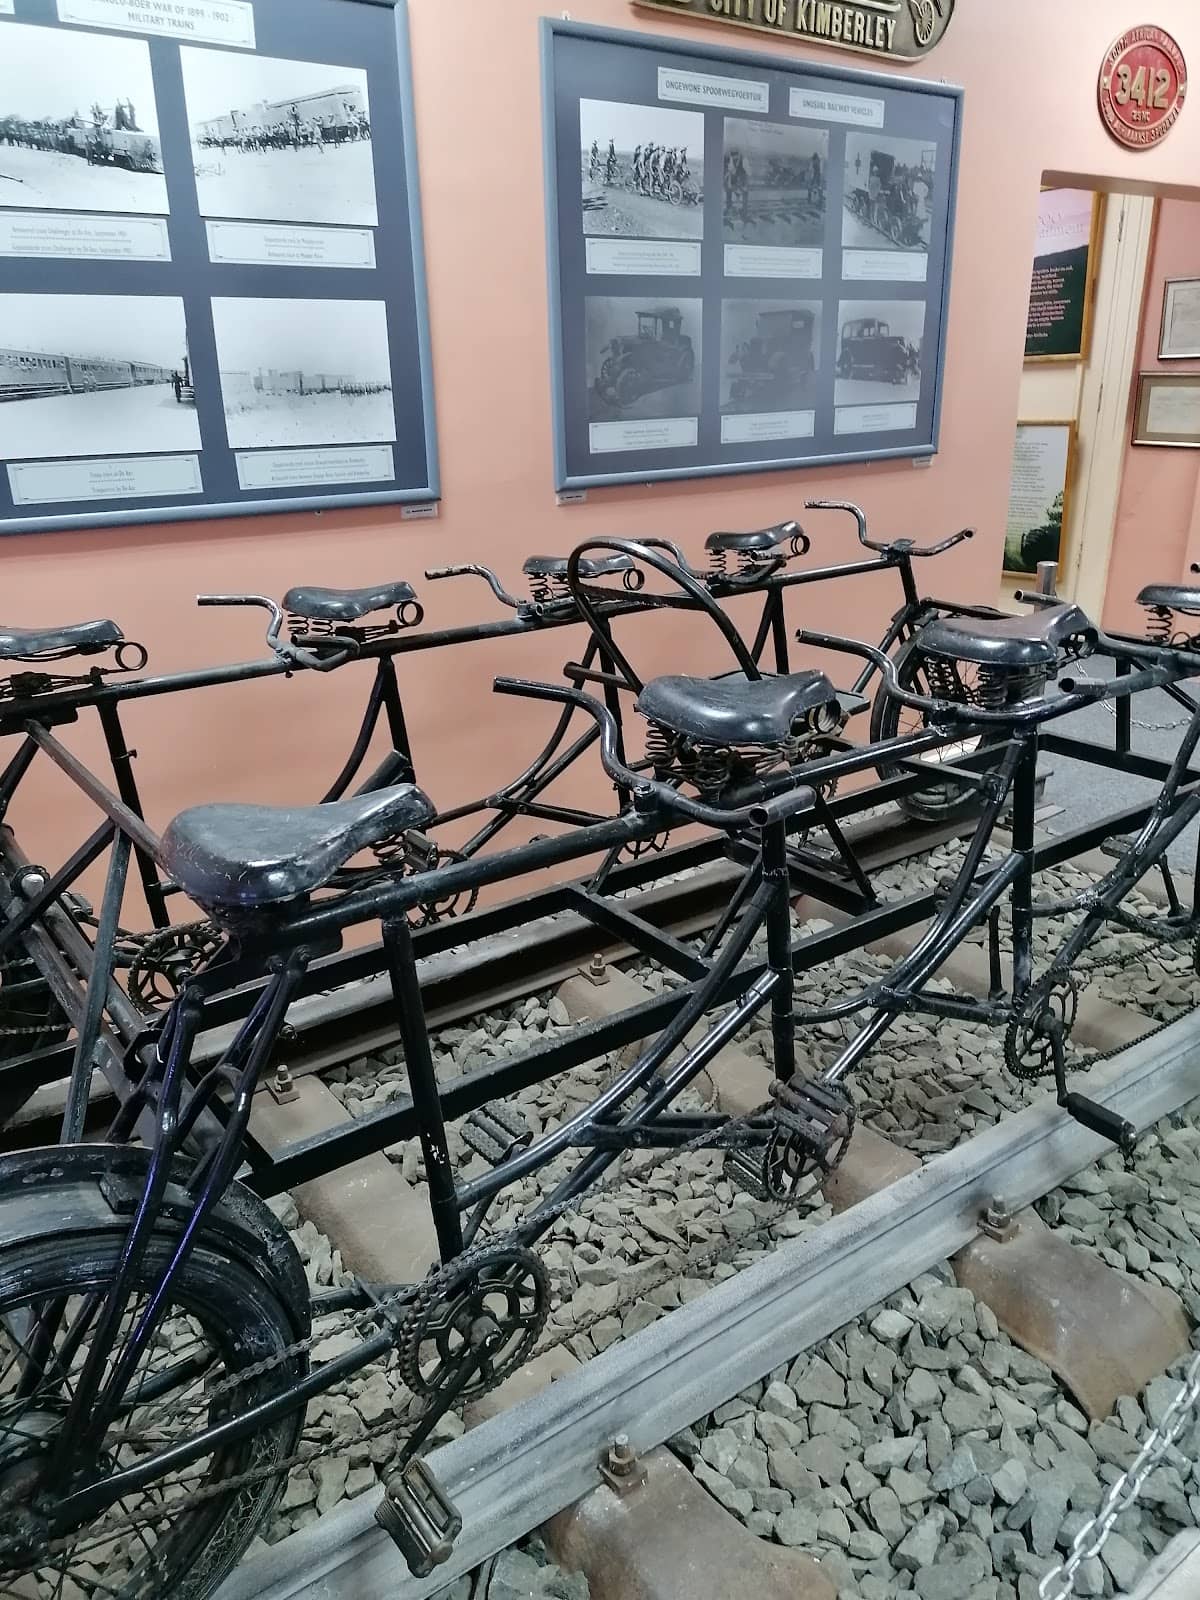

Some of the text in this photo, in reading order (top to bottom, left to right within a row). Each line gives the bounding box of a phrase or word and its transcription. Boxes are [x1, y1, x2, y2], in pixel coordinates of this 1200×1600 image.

[127, 11, 195, 30] MILITARY TRAINS
[152, 2, 172, 12] WAR
[174, 5, 184, 15] OF
[212, 11, 230, 22] 1902
[763, 0, 787, 26] OF
[796, 0, 897, 50] KIMBERLEY
[665, 79, 701, 95] ONGEWONE
[1115, 63, 1170, 109] 3412
